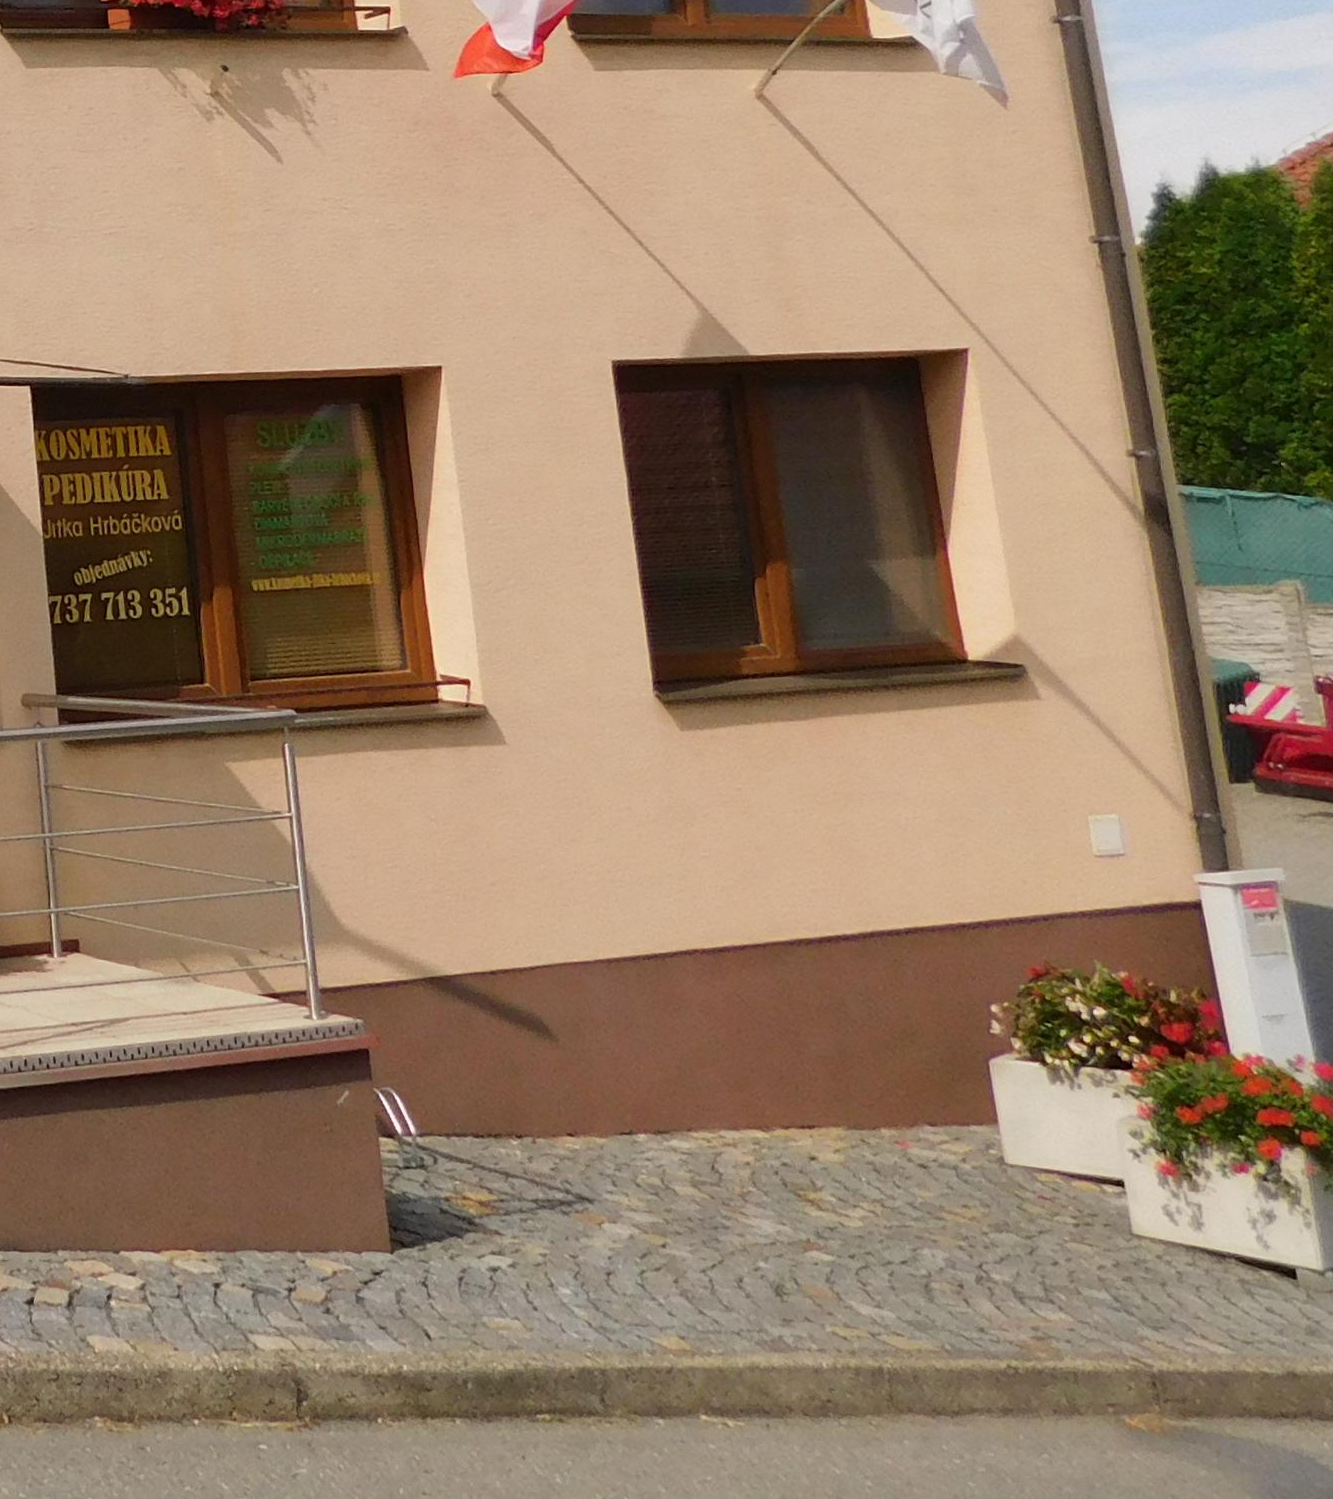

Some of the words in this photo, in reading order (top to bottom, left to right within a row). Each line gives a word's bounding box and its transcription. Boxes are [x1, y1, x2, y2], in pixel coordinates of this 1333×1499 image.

[35, 424, 172, 461] KOSMETIKA
[42, 464, 169, 506] PEDIKÚRA
[89, 509, 183, 536] Hrbáčková
[73, 549, 154, 586] objednávky:
[48, 592, 93, 624] 737
[100, 589, 143, 620] 713
[149, 585, 191, 618] 351
